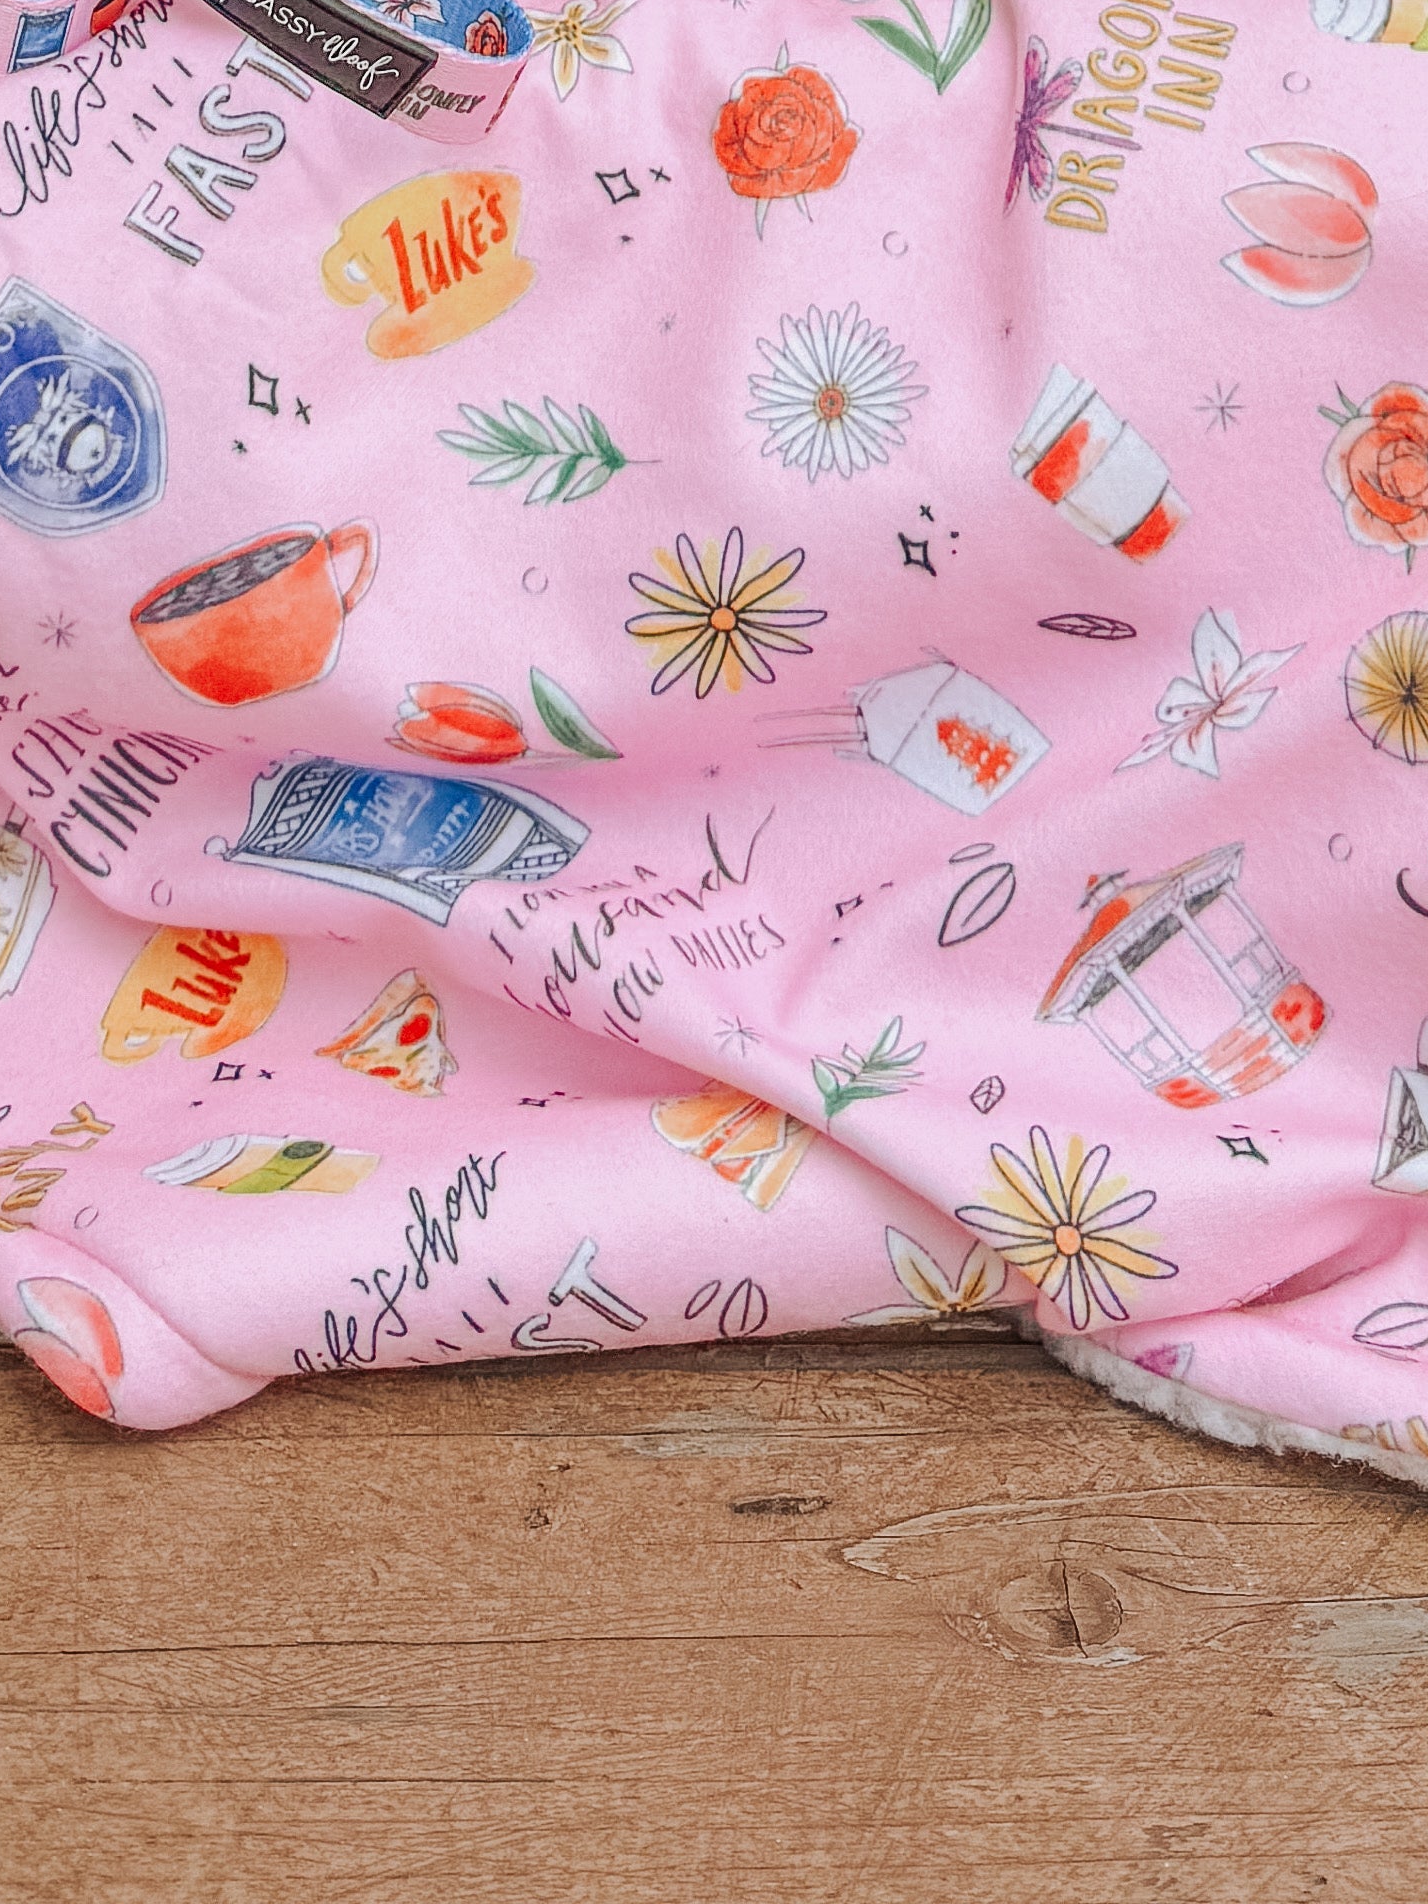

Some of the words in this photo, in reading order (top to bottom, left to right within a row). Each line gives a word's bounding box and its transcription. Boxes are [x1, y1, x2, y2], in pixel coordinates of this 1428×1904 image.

[322, 34, 400, 90] Woof
[1143, 10, 1239, 134] INN
[124, 39, 314, 267] FAST
[380, 185, 511, 315] Luke's
